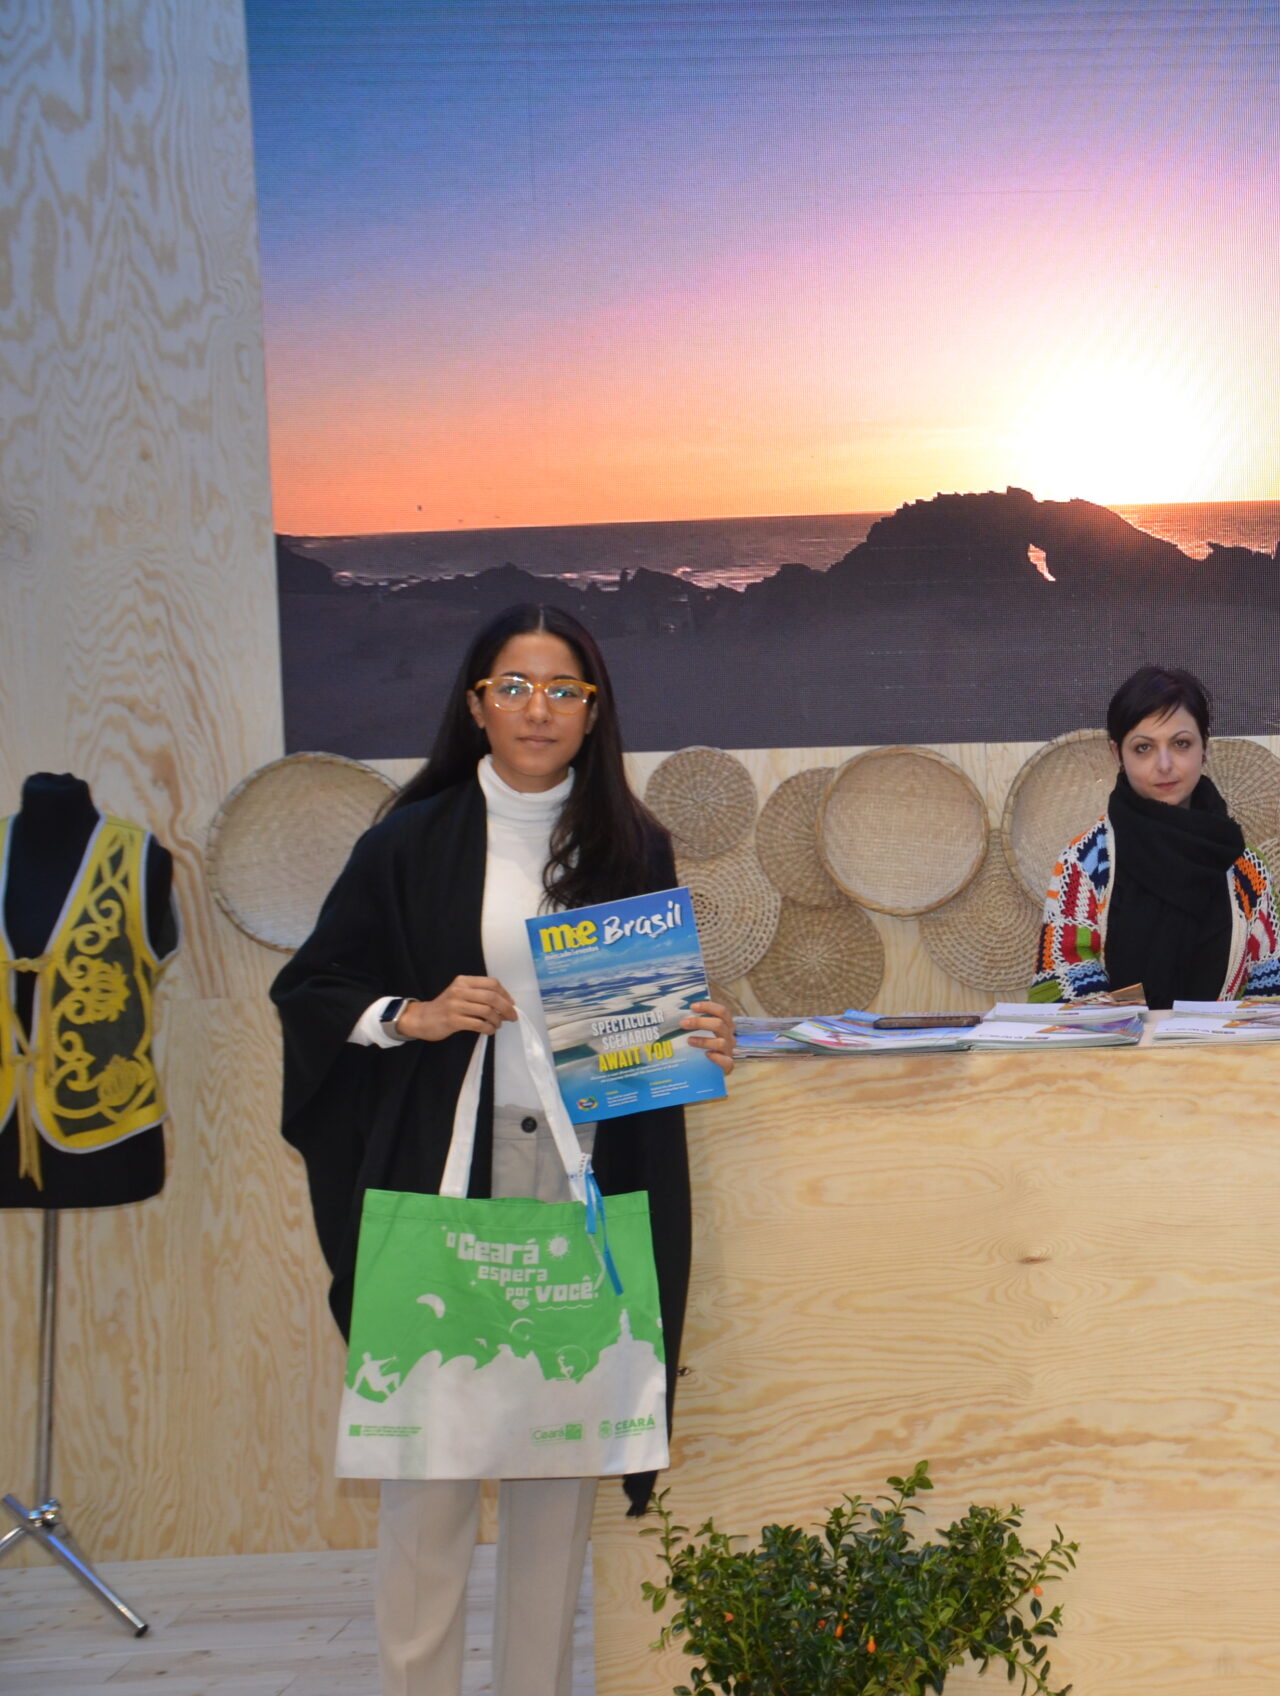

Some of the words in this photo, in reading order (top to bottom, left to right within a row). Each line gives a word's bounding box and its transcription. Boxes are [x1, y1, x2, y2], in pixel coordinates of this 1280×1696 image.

[602, 900, 682, 945] Brasil
[591, 1008, 665, 1037] SPECTACULAR
[602, 1026, 660, 1050] SCENARIOS
[598, 1046, 641, 1073] AWAIT
[643, 1039, 675, 1063] YOU
[457, 1232, 539, 1265] Ceará
[477, 1265, 548, 1287] espera
[505, 1286, 533, 1301] por
